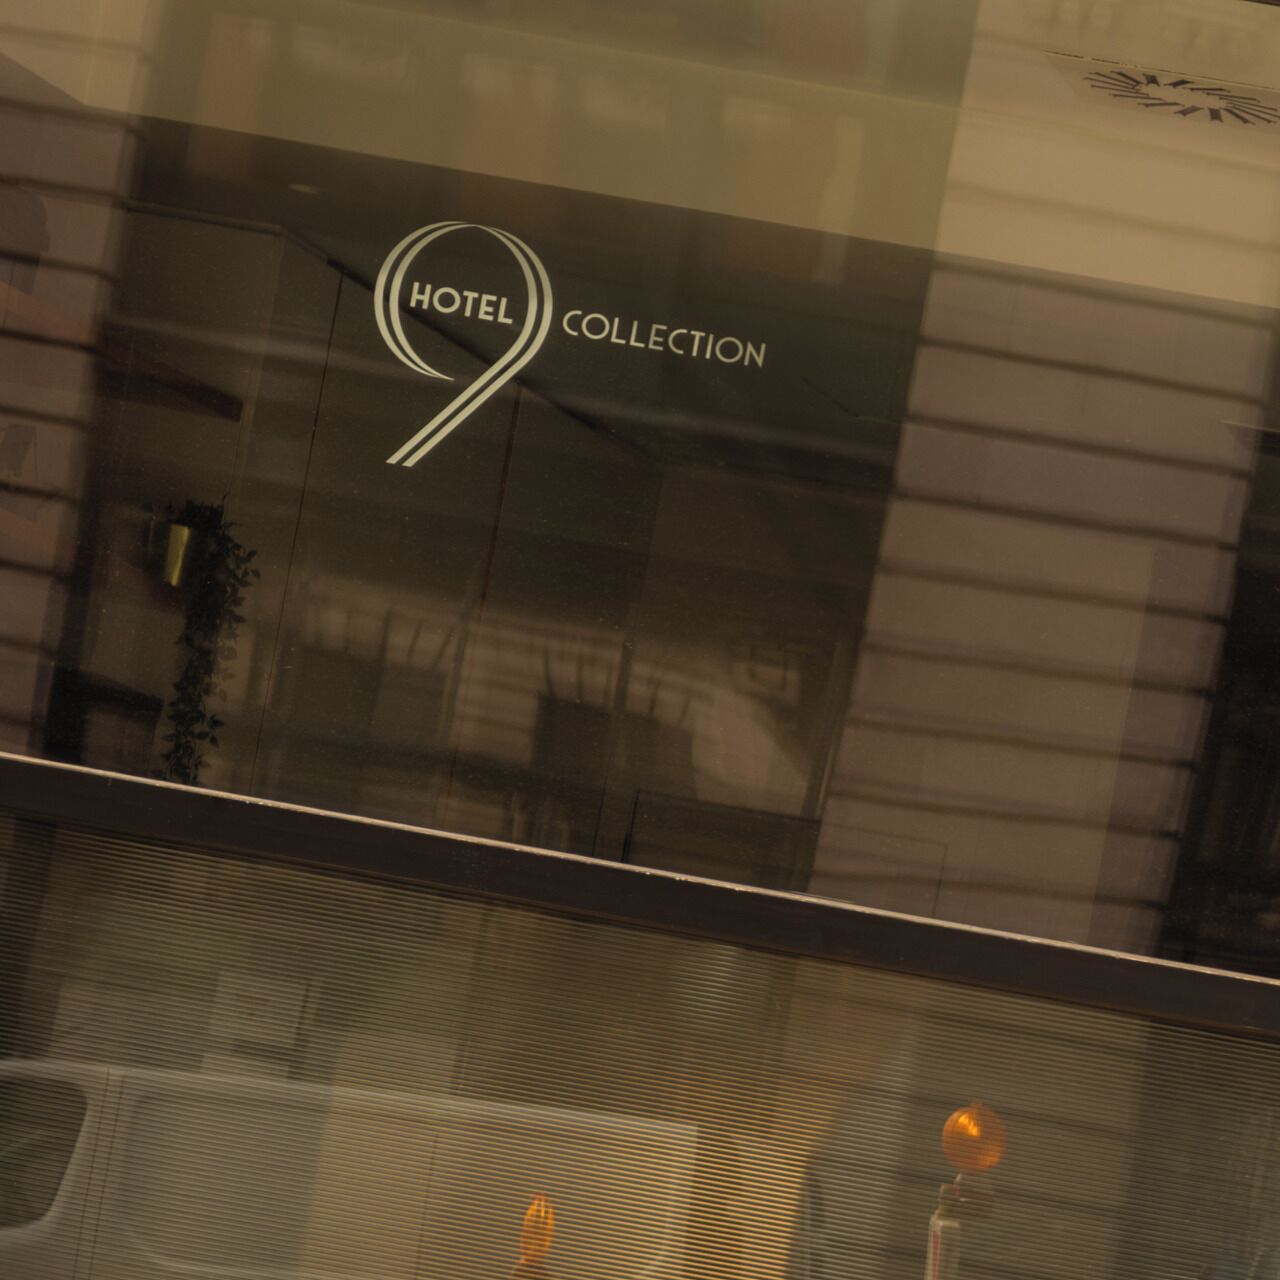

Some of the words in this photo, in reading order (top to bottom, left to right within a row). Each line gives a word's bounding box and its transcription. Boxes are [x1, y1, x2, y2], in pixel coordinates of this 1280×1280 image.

[409, 281, 513, 324] HOTEL
[373, 221, 553, 467] 9
[562, 310, 766, 368] COLLECTION
